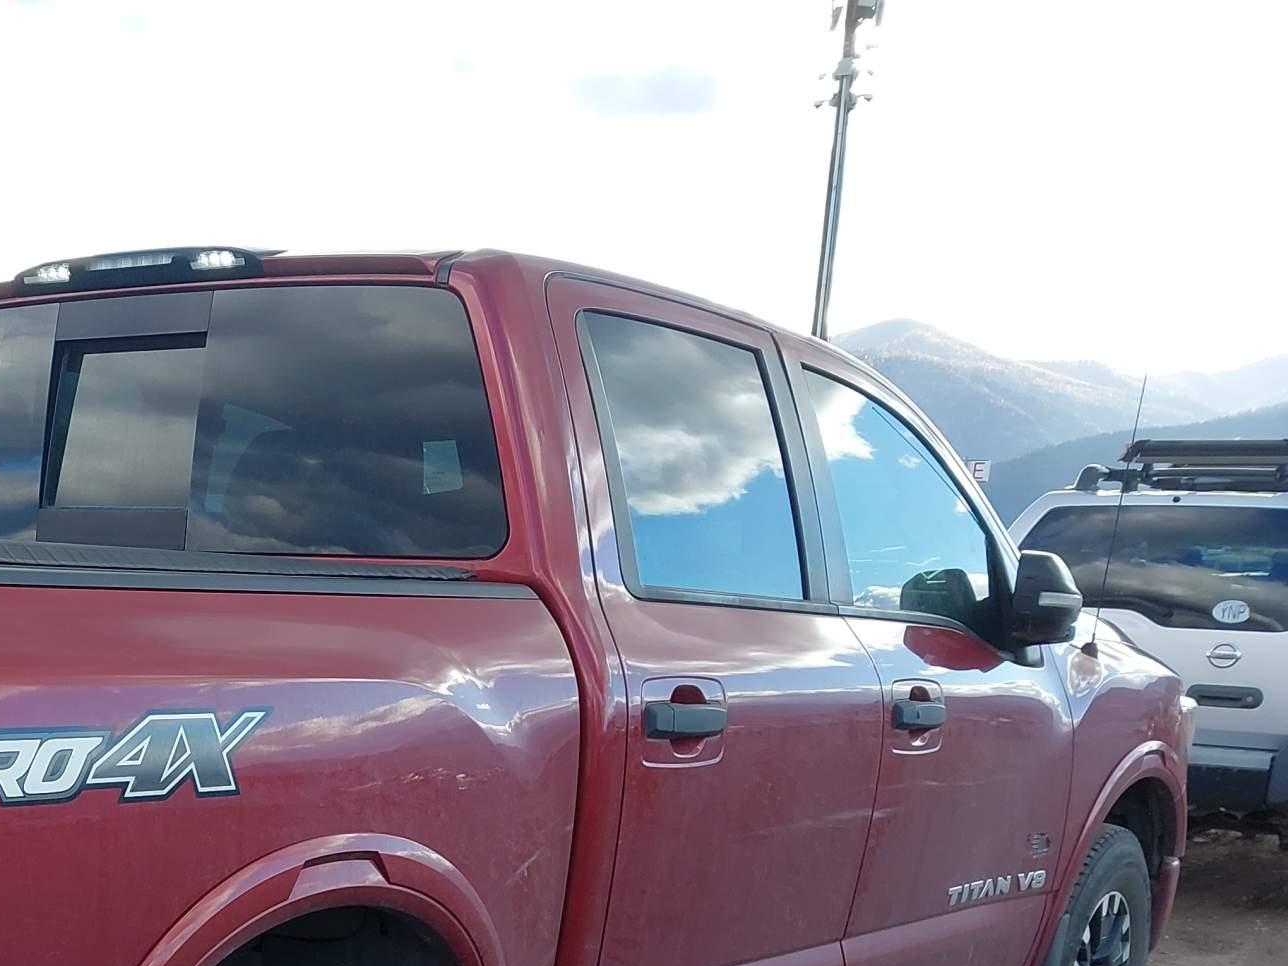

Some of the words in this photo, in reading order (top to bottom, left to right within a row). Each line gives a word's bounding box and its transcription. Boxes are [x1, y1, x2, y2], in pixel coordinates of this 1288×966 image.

[1221, 604, 1246, 620] YNP
[948, 878, 1012, 906] TITAN
[1017, 870, 1047, 892] V8
